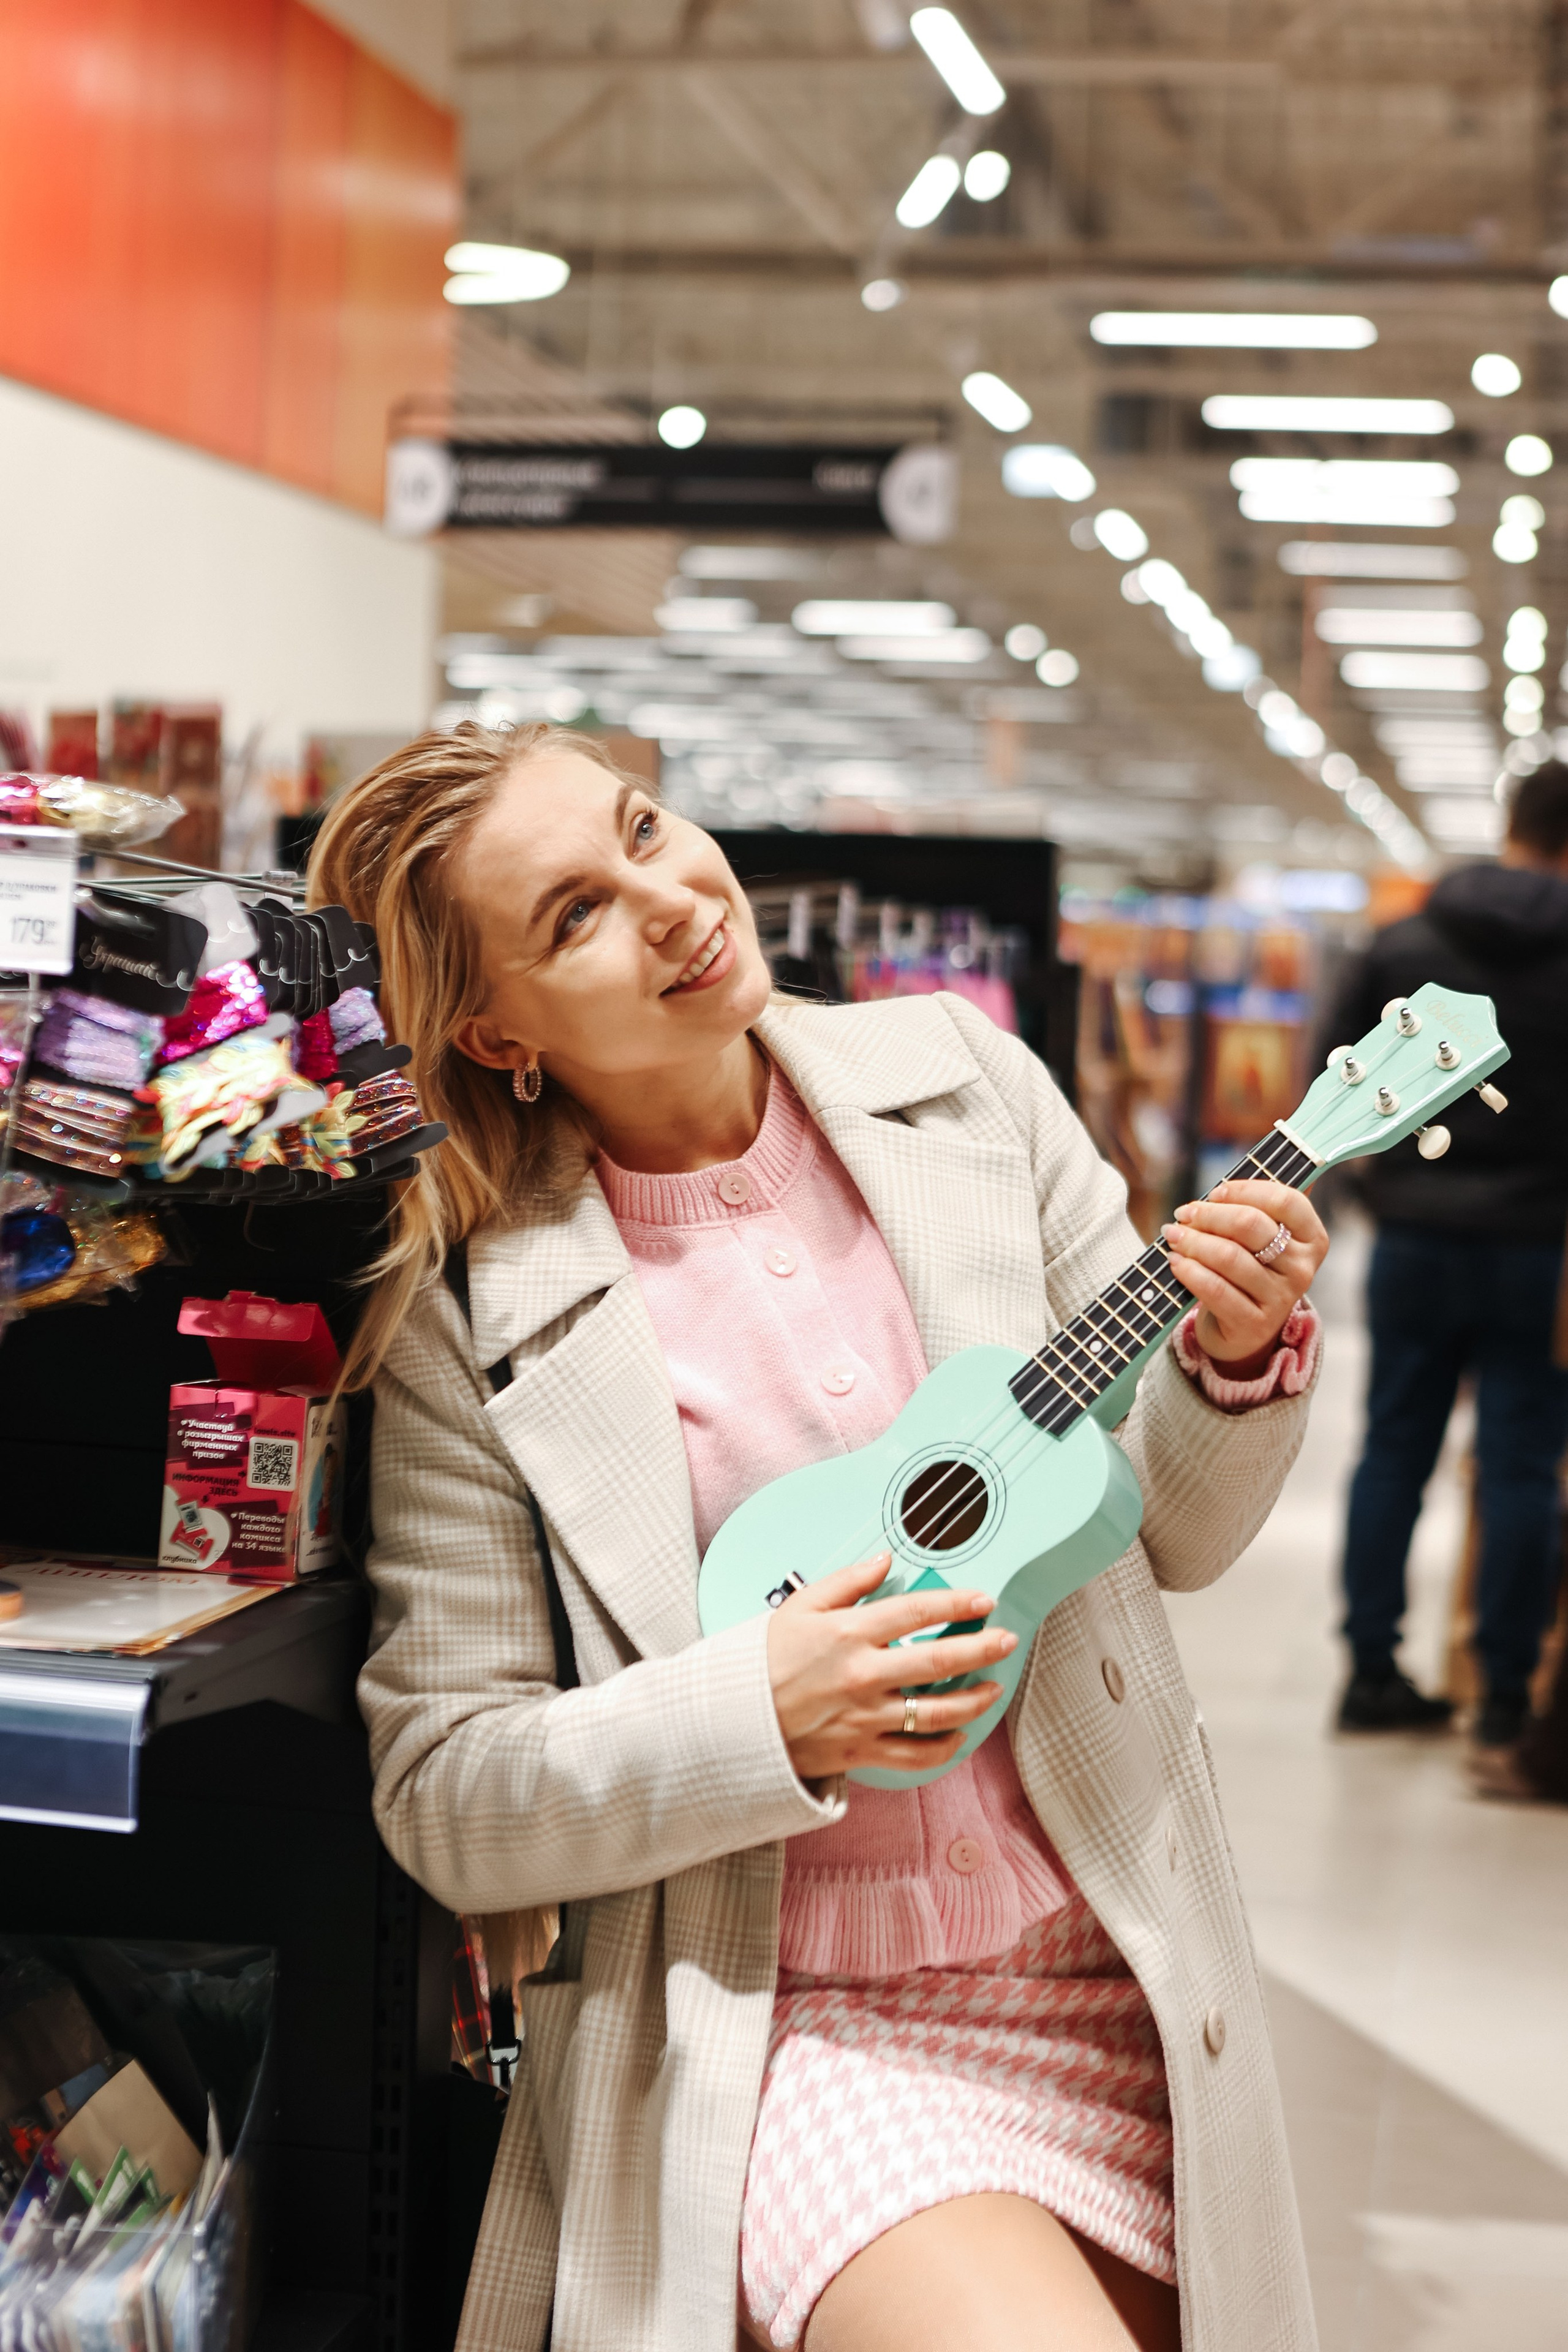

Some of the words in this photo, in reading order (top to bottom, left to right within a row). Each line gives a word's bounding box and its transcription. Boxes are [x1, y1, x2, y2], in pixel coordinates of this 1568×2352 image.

[188, 1419, 234, 1433] Участвуй
[184, 1431, 244, 1442] розыгрышах
[181, 1439, 238, 1451] фирменных
[173, 1473, 239, 1487] ИНФОРМАЦИЯ
[209, 1487, 238, 1496] ЗДЕСЬ
[238, 1512, 285, 1524] Переводы
[241, 1523, 281, 1533] каждого
[239, 1533, 281, 1542] комикса
[245, 1542, 256, 1550] 34
